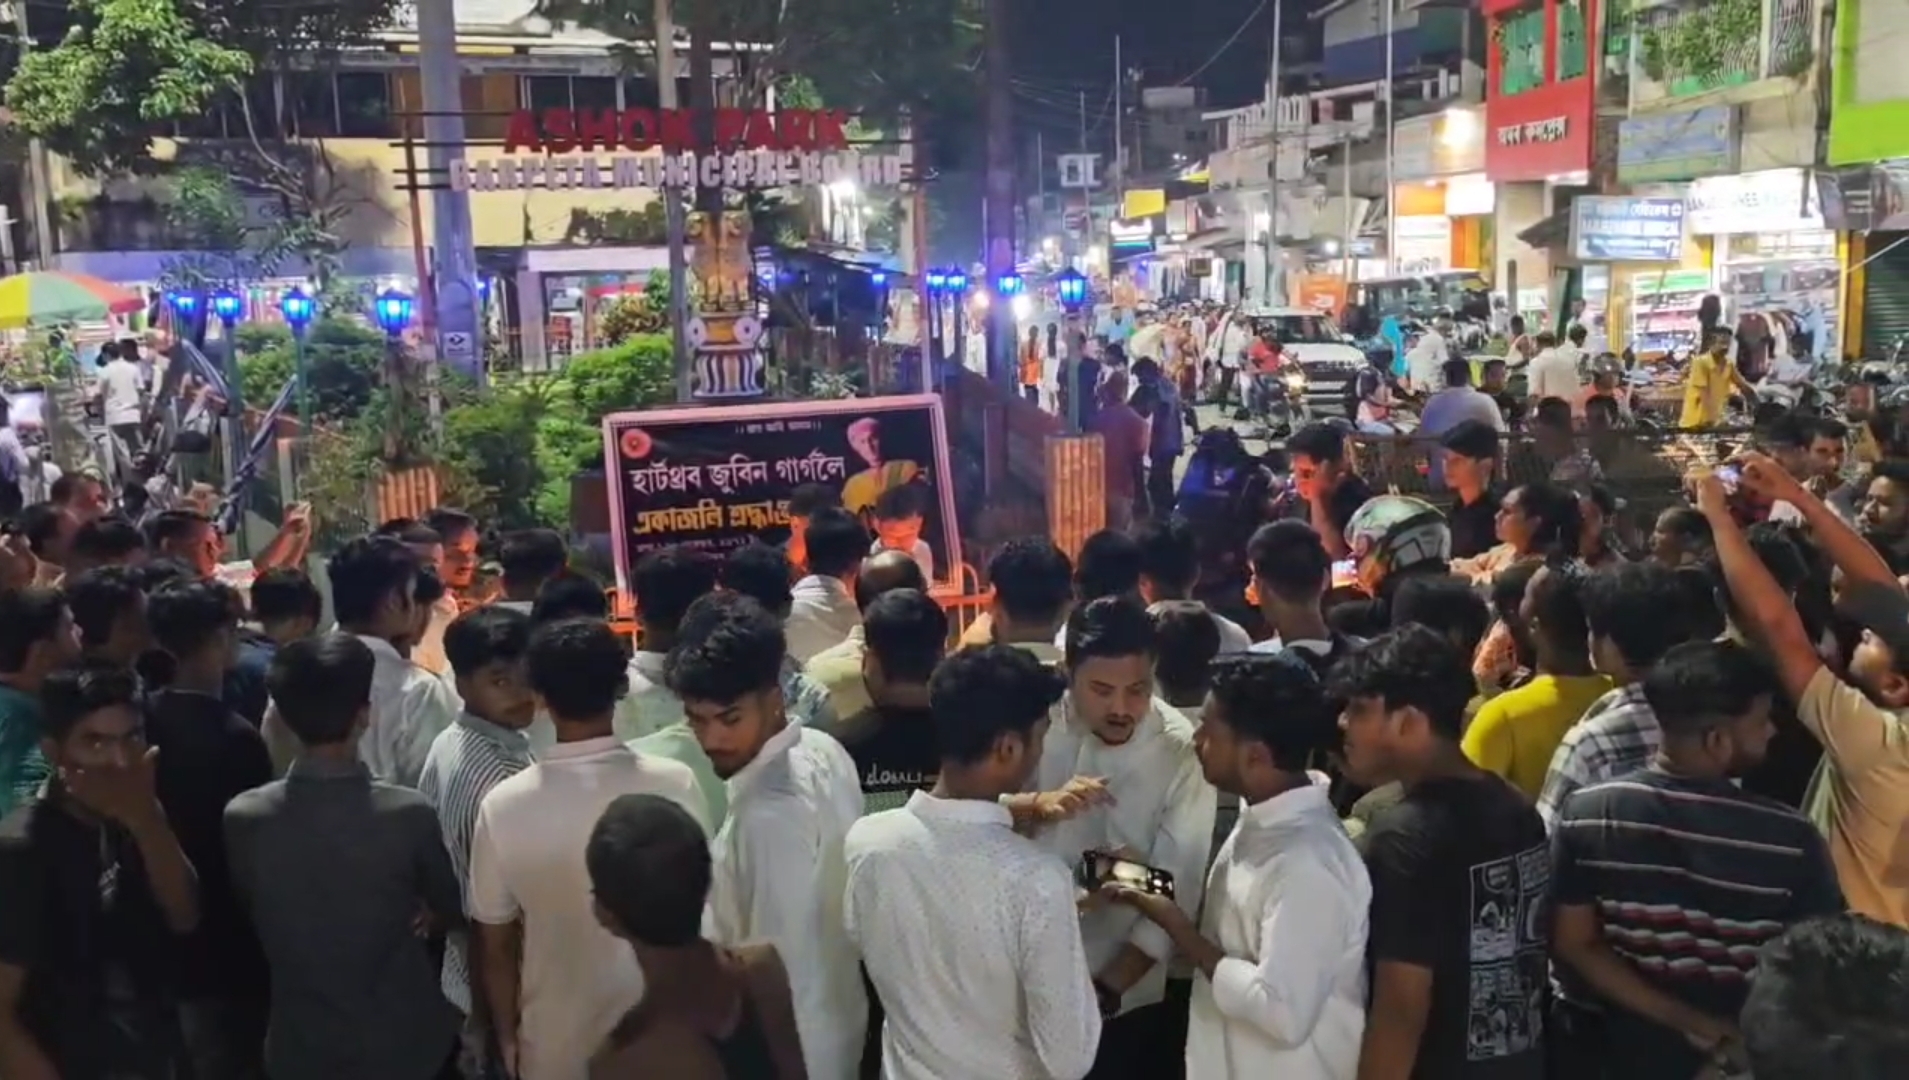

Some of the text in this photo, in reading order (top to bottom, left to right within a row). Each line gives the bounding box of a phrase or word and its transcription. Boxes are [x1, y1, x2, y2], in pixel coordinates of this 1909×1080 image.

[503, 107, 693, 155] ASHOK
[715, 106, 849, 151] PARK
[450, 149, 900, 191] BARPETA MUNICIPAL BOARD
[707, 455, 767, 493] জুবিন
